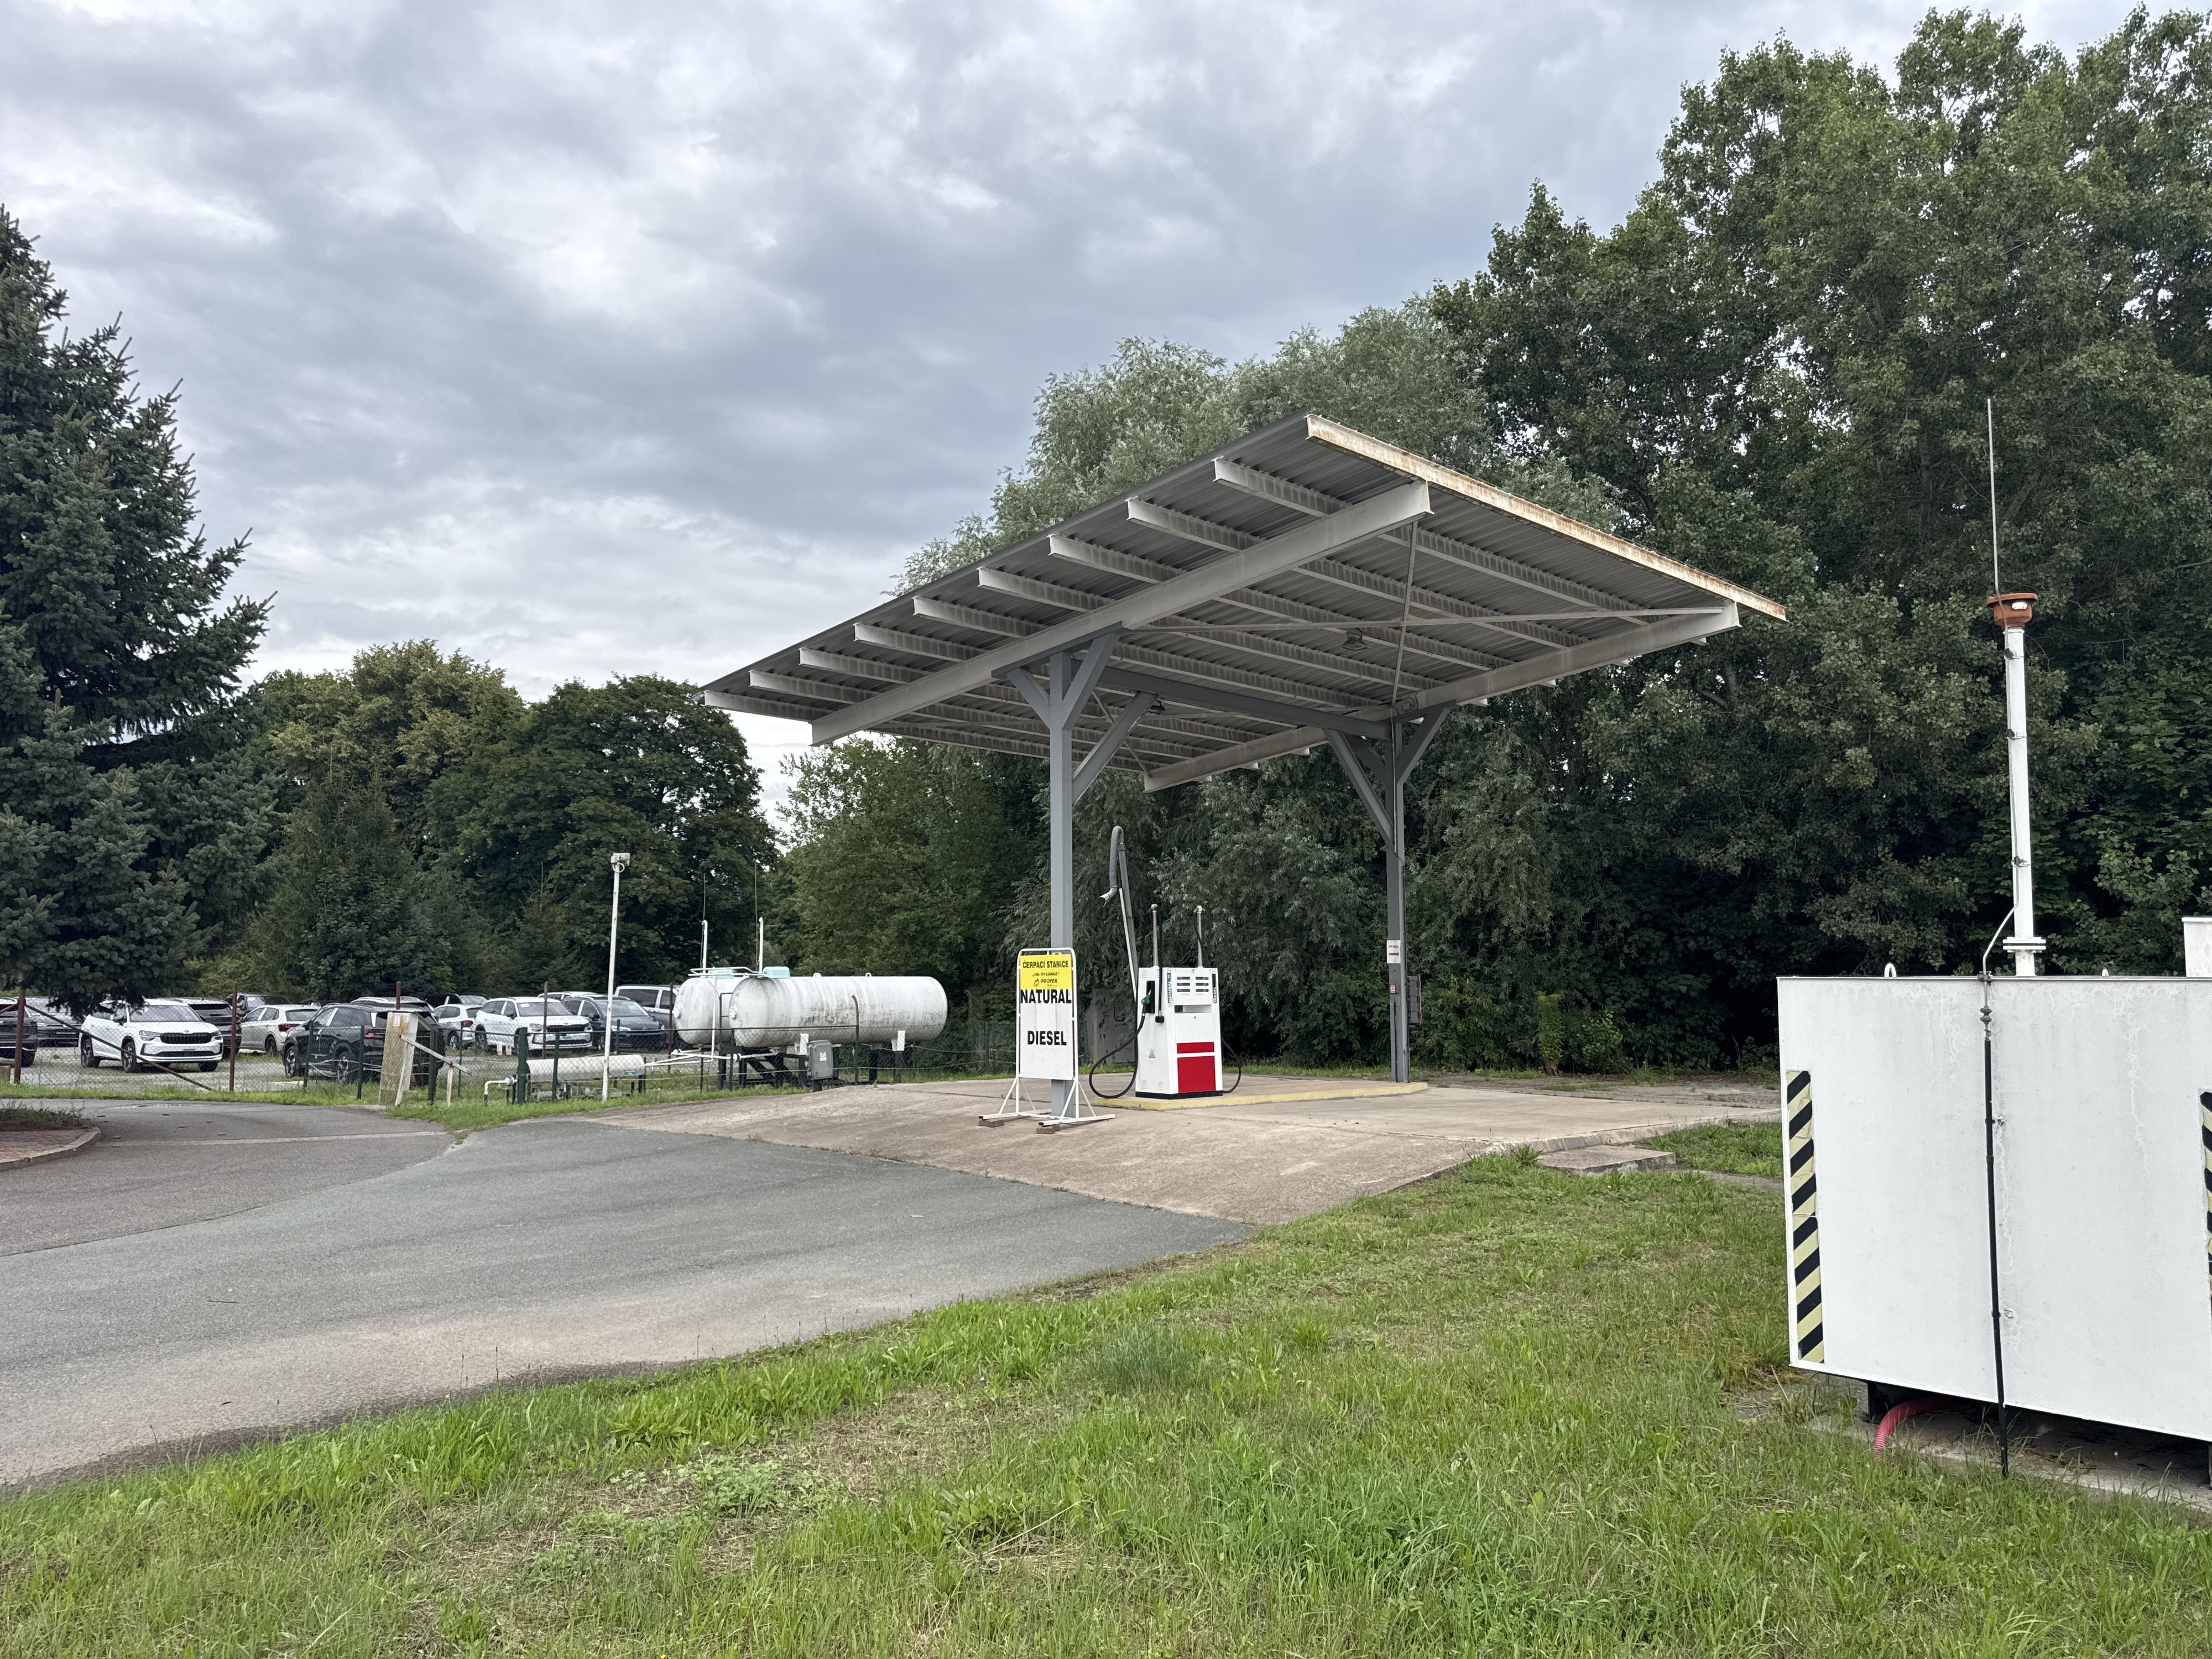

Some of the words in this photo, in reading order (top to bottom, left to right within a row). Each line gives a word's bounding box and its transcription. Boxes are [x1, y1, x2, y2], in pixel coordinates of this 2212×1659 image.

[1022, 960, 1045, 968] ČERPACÍ
[1021, 989, 1071, 1003] NATURAL
[1027, 1030, 1067, 1046] DIESEL
